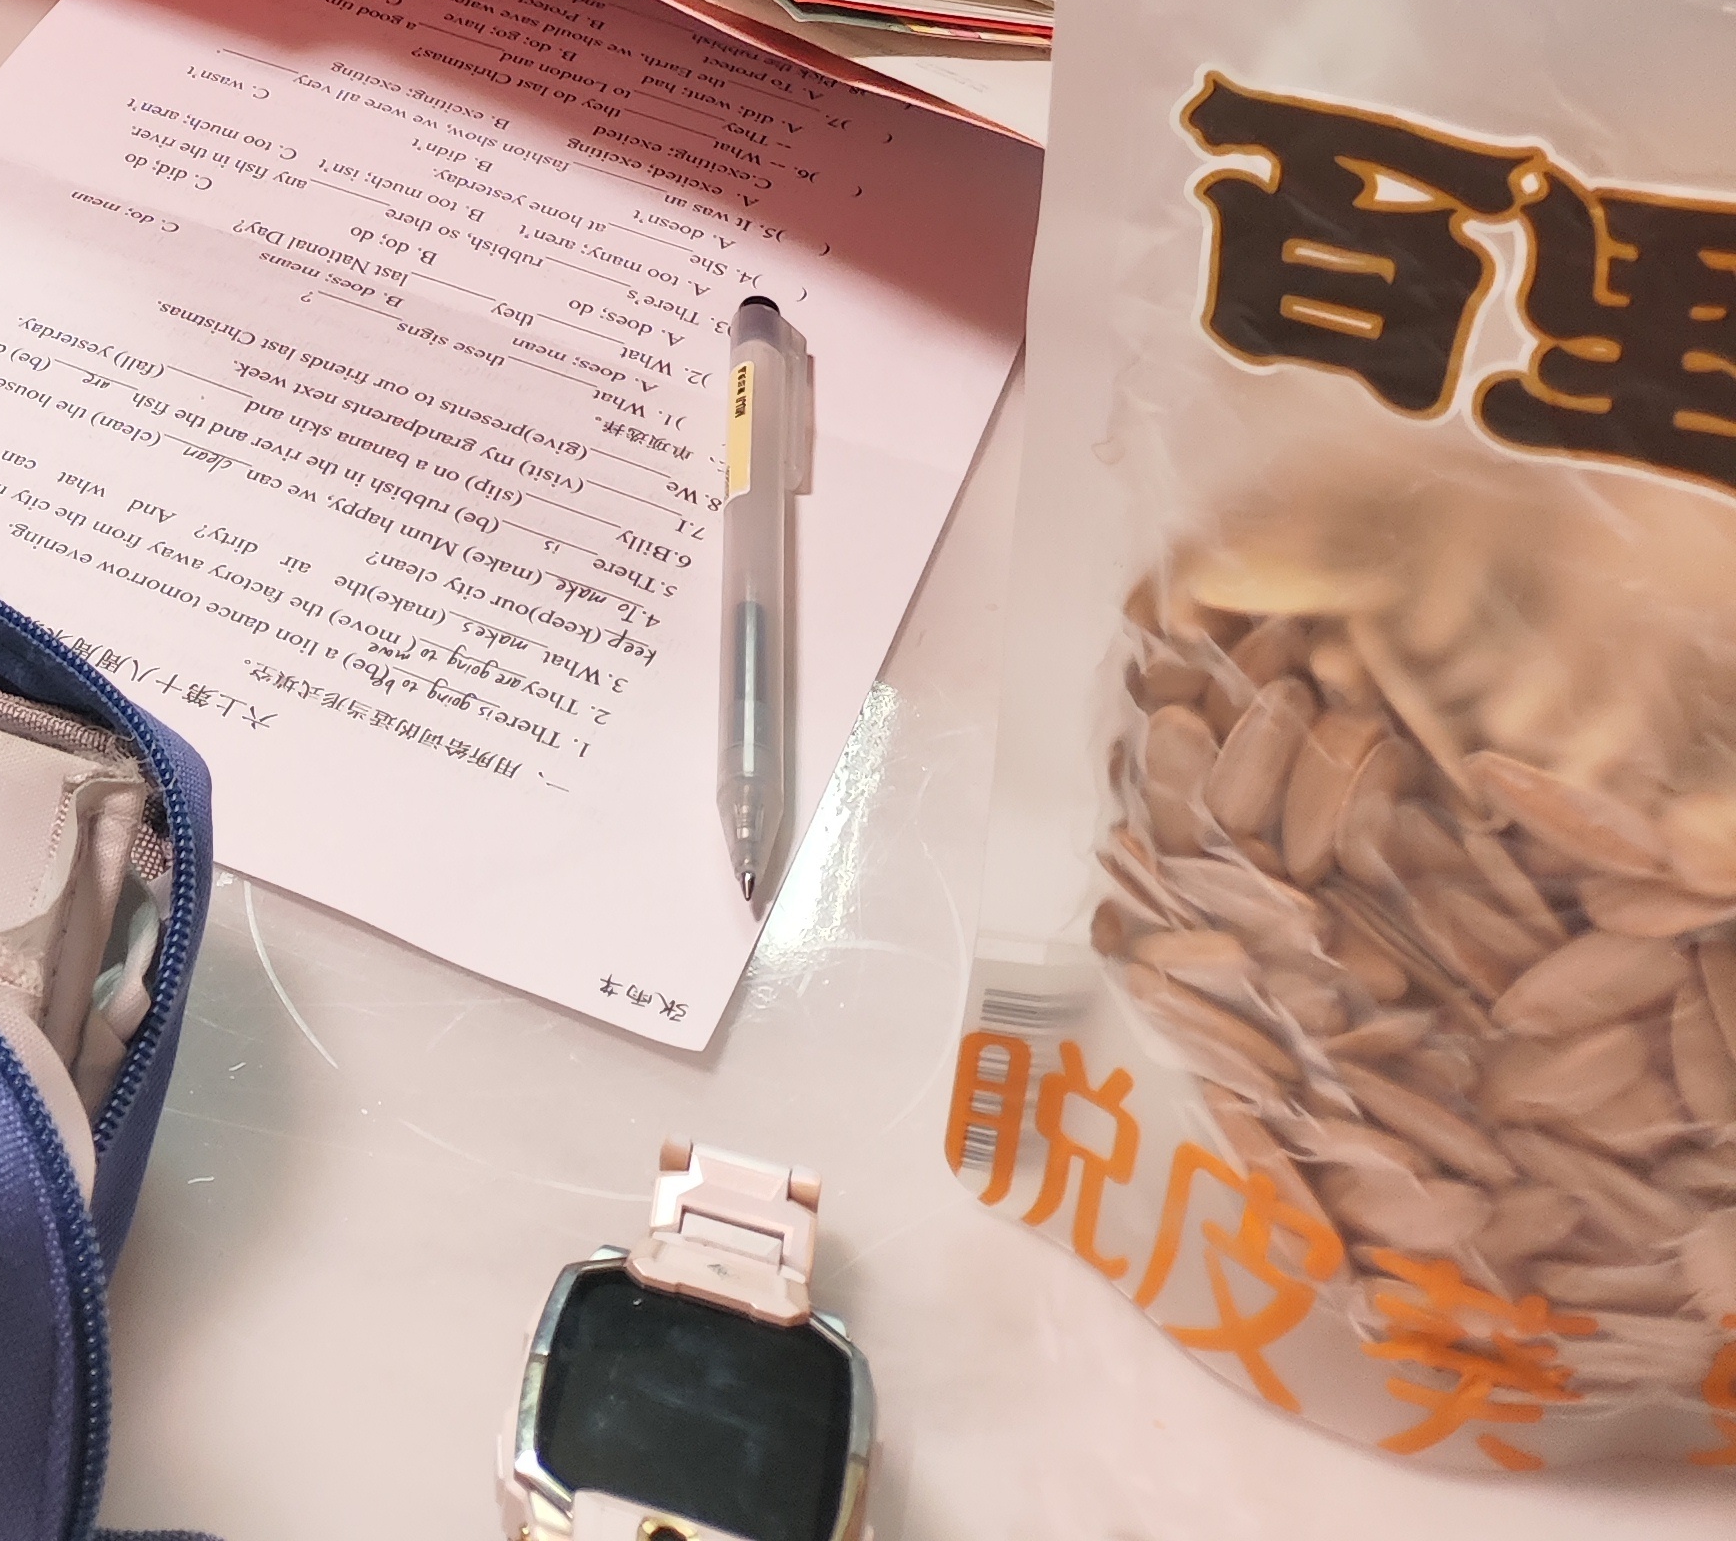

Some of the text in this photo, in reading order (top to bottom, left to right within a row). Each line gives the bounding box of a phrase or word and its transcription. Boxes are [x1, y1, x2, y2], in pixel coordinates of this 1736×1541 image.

[131, 126, 178, 149] river.
[180, 143, 208, 160] the
[212, 152, 232, 169] in
[235, 160, 270, 181] fish
[272, 171, 308, 190] any
[385, 209, 433, 233] there
[438, 226, 461, 240] so
[467, 233, 544, 268] rubbish,
[158, 301, 257, 346] Christmas.
[18, 317, 115, 359] yesterday.
[260, 338, 298, 362] last
[10, 348, 52, 373] (be)
[114, 351, 165, 379] (fall)
[300, 353, 370, 386] friends
[82, 374, 111, 390] are
[234, 360, 287, 389] week.
[292, 383, 339, 405] next
[373, 378, 410, 396] our
[56, 401, 88, 420] the
[132, 393, 171, 416] fish
[244, 400, 285, 421] and
[414, 392, 436, 407] to
[90, 412, 162, 448] (clean)
[174, 409, 206, 429] the
[289, 415, 334, 438] skin
[342, 399, 478, 452] grandparents
[207, 422, 249, 442] and
[2, 450, 37, 470] can
[183, 447, 233, 474] clean
[250, 437, 304, 462] river
[337, 431, 411, 469] banana
[479, 447, 516, 467] my
[306, 456, 340, 476] the
[416, 459, 430, 471] a
[433, 465, 461, 482] on
[57, 472, 106, 499] what
[246, 469, 284, 489] can
[344, 468, 367, 488] in
[519, 460, 585, 495] (visit)
[11, 490, 52, 511] city
[287, 485, 317, 503] we
[370, 478, 451, 515] rubbish
[465, 475, 524, 507] (slip)
[55, 507, 88, 527] the
[127, 499, 178, 524] And
[327, 495, 396, 535] happy,
[454, 507, 500, 535] (be)
[93, 521, 143, 549] from
[194, 525, 259, 556] dirty?
[400, 524, 460, 558] Mum
[147, 541, 205, 570] away
[544, 540, 561, 555] is
[279, 556, 312, 574] air
[365, 551, 439, 583] clean?
[463, 546, 543, 587] (make)
[208, 564, 285, 604] factory
[443, 577, 487, 601] city
[555, 579, 608, 604] make
[290, 597, 324, 618] the
[617, 603, 638, 625] To
[642, 611, 661, 629] 4.
[9, 523, 591, 759] 1. There is going to be (be) a lion dance tomorrow evening.
[462, 622, 529, 651] makes
[607, 629, 658, 668] keep
[368, 642, 412, 661] move
[420, 648, 438, 663] to
[446, 644, 499, 680] going
[34, 620, 279, 731] 六上第十八周周
[494, 673, 523, 689] are
[520, 681, 579, 716] They
[591, 706, 612, 726] 2.
[944, 1029, 1736, 1473] 脱皮葵
